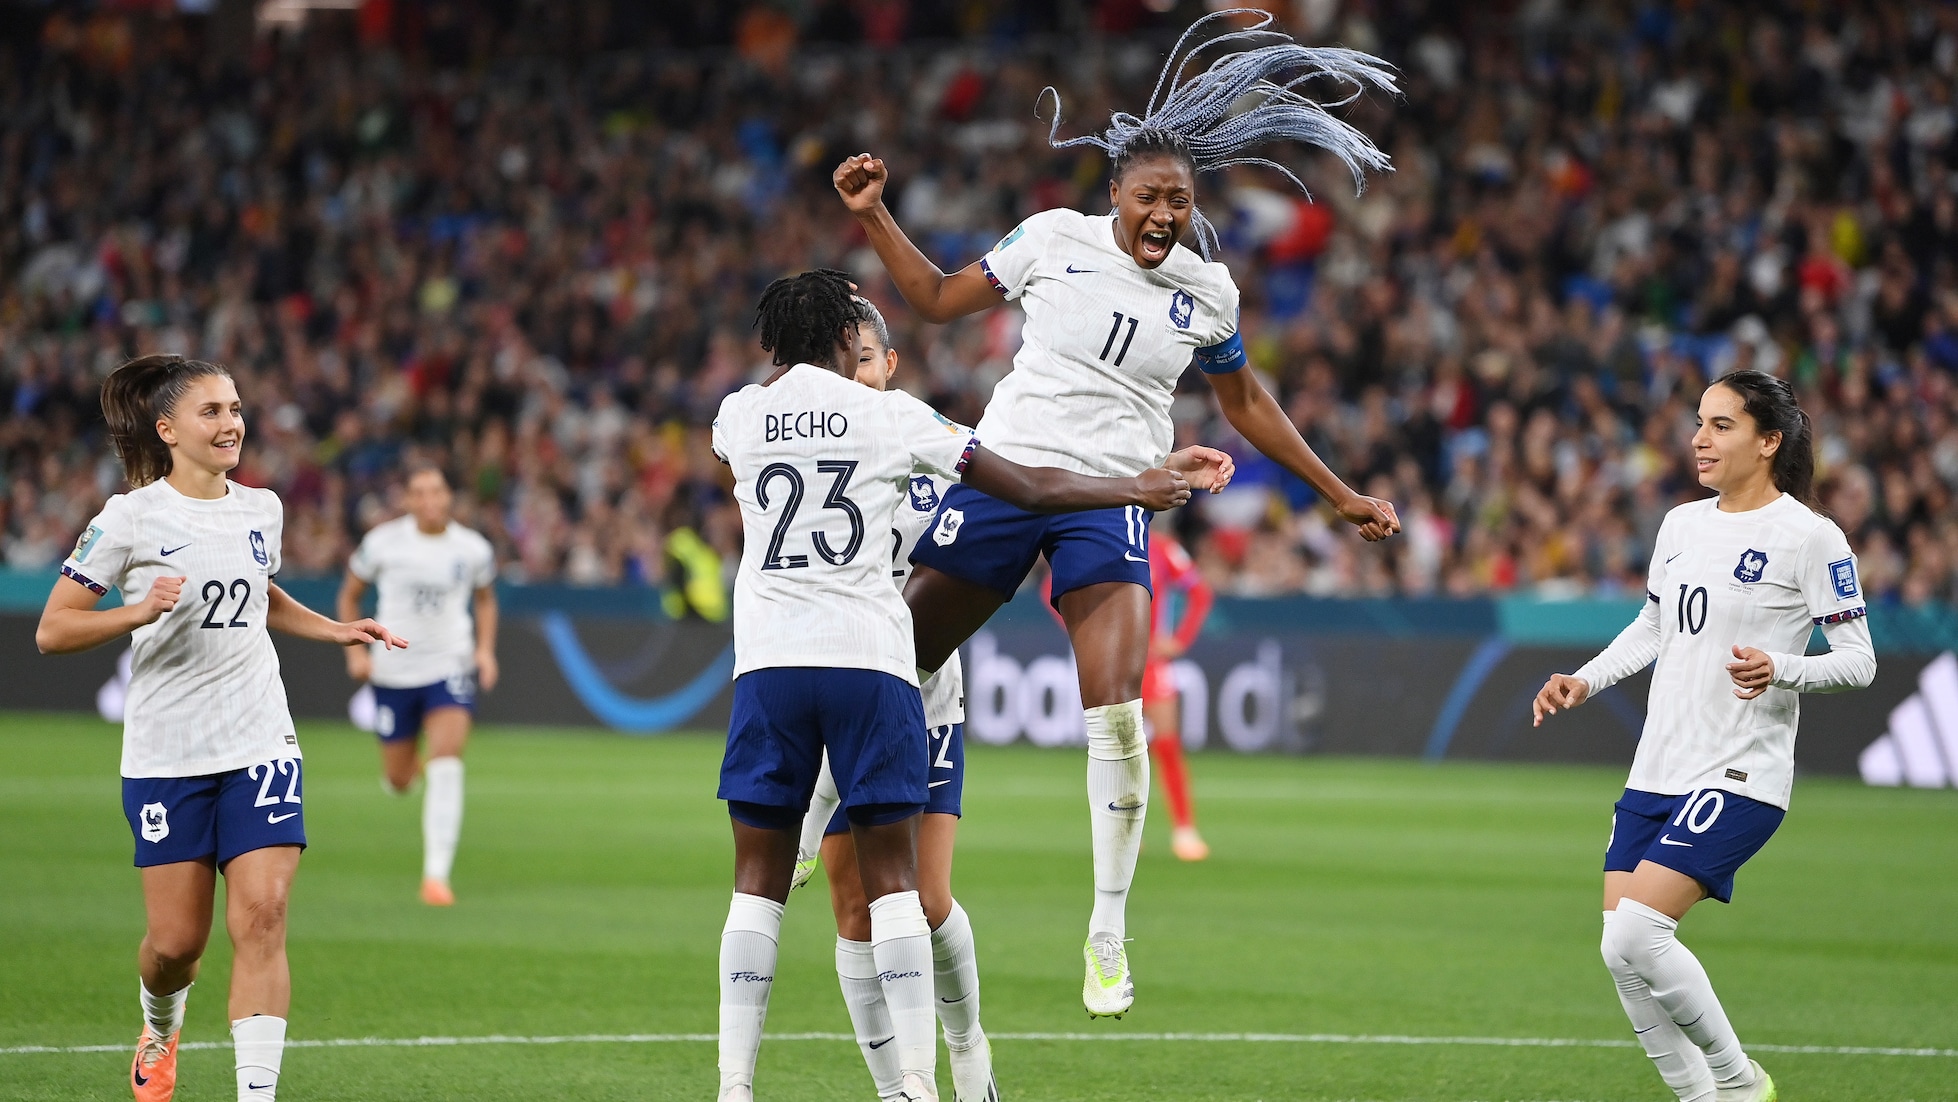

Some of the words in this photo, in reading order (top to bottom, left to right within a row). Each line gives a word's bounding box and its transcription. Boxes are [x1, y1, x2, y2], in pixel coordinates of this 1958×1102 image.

[1099, 311, 1139, 367] 11
[765, 411, 848, 443] BECHO
[755, 460, 865, 571] 23
[1124, 505, 1145, 551] 11
[200, 578, 251, 629] 22
[1678, 583, 1708, 636] 10
[926, 724, 953, 769] 2
[248, 757, 301, 808] 22
[1673, 788, 1725, 834] 10
